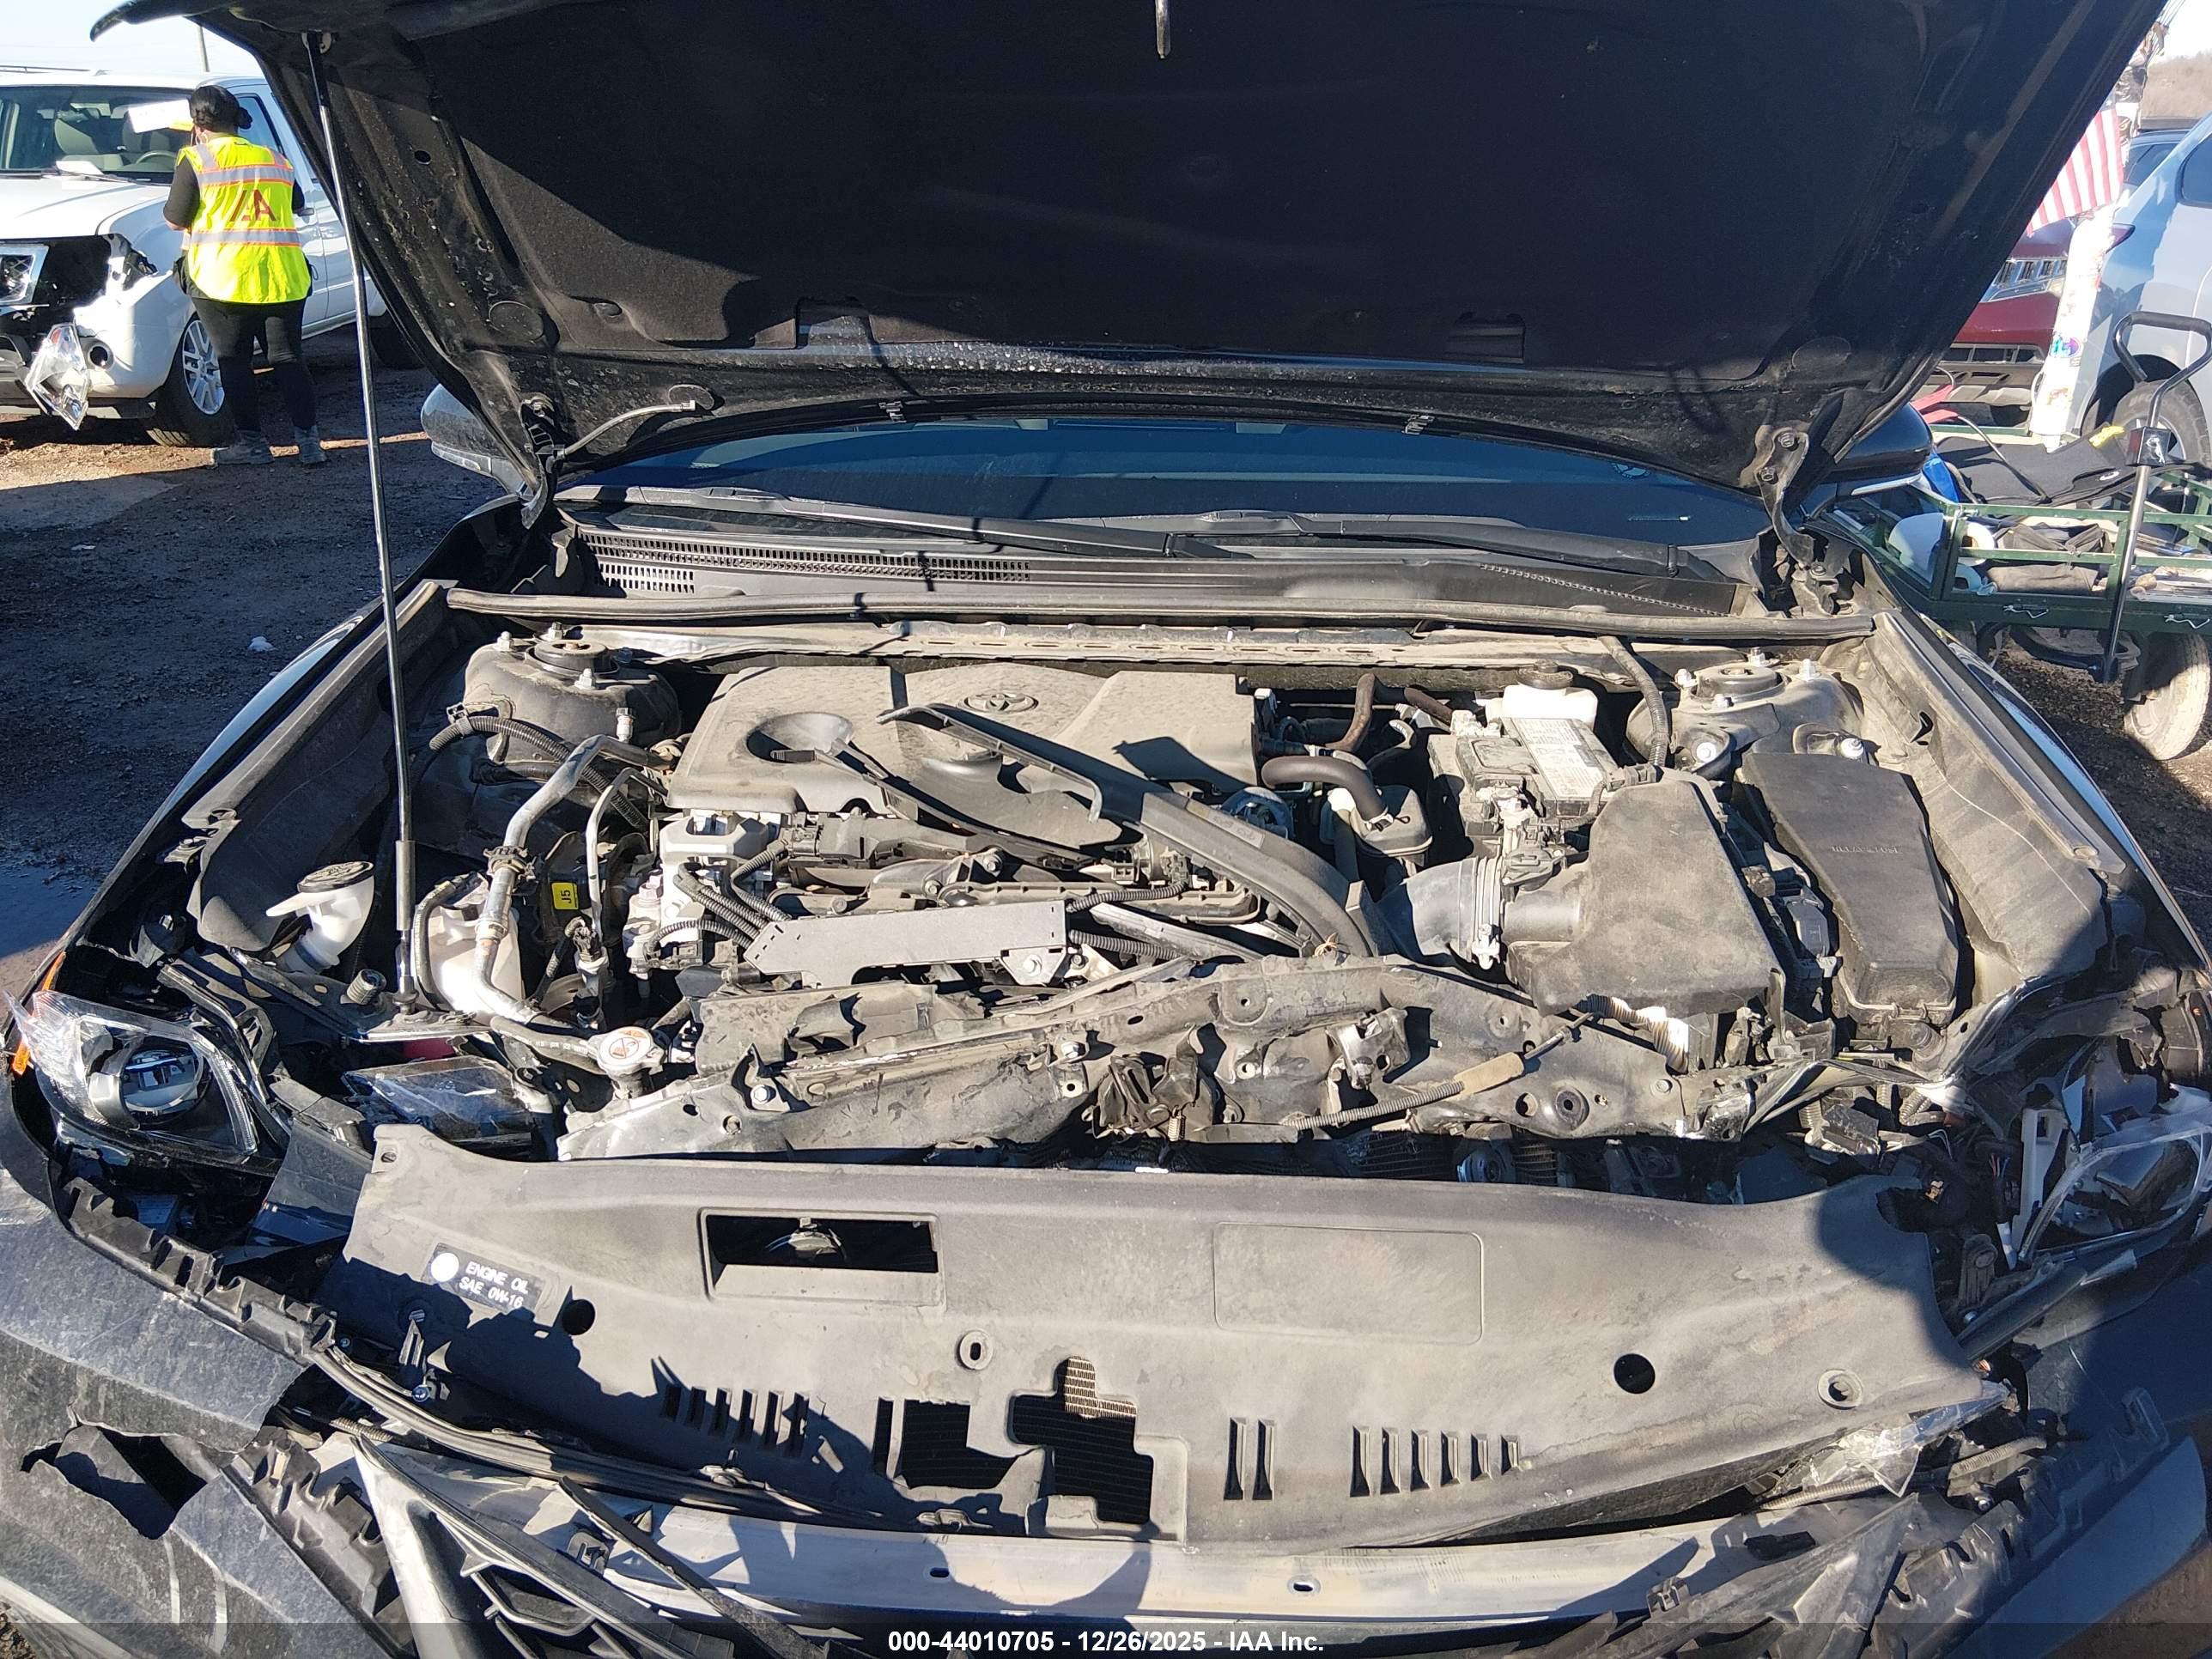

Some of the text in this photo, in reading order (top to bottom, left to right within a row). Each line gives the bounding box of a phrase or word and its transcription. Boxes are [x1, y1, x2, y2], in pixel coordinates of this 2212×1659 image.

[560, 890, 572, 904] J5
[459, 1276, 525, 1310] SAE 0W-16
[465, 1261, 529, 1294] ENGINE OIL
